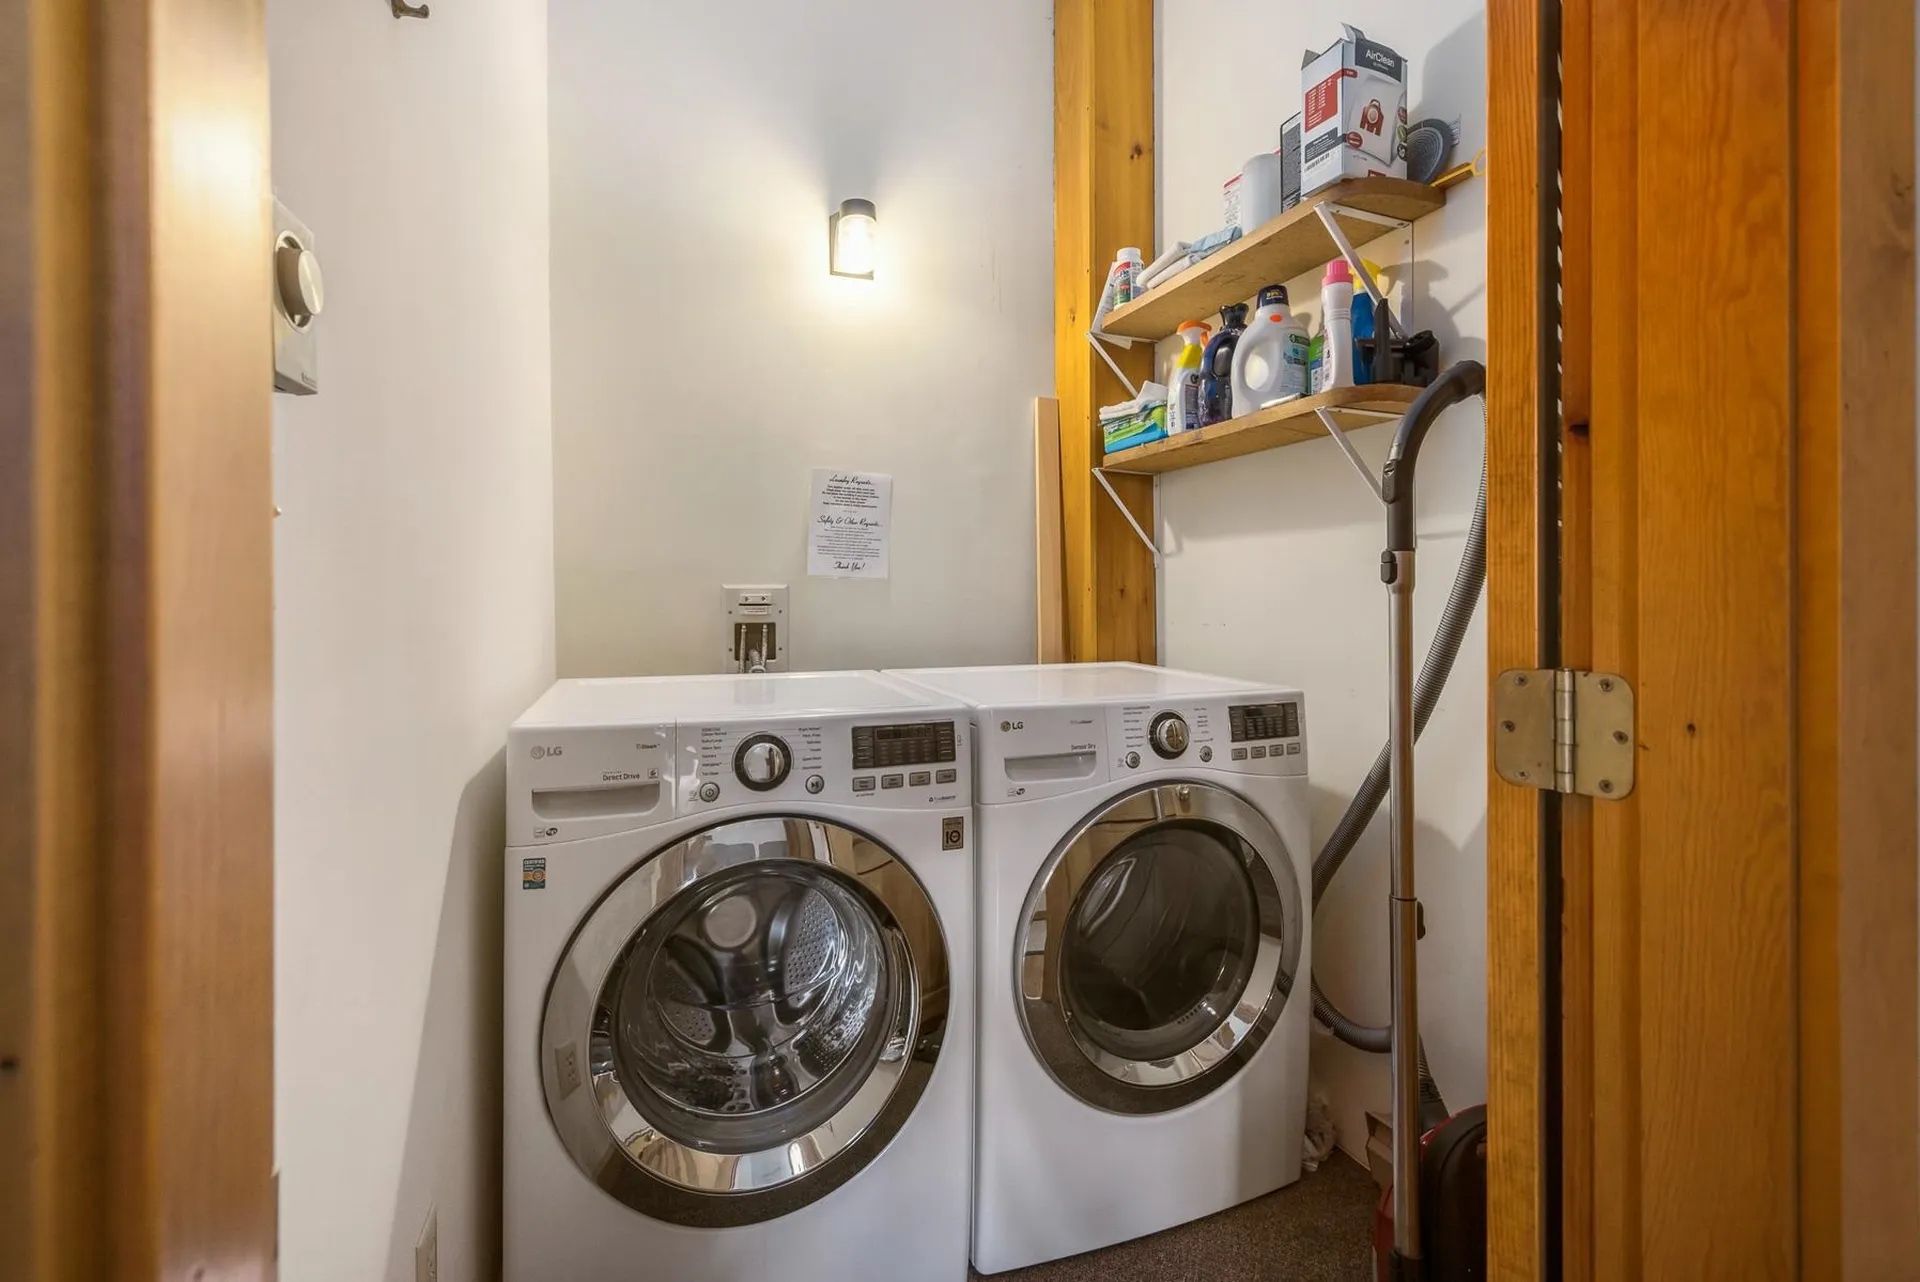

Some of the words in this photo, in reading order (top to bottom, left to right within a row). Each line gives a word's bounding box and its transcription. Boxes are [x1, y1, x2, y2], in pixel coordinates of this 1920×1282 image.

[1365, 49, 1395, 68] AirClean
[1012, 721, 1024, 730] LG
[547, 746, 562, 757] LG
